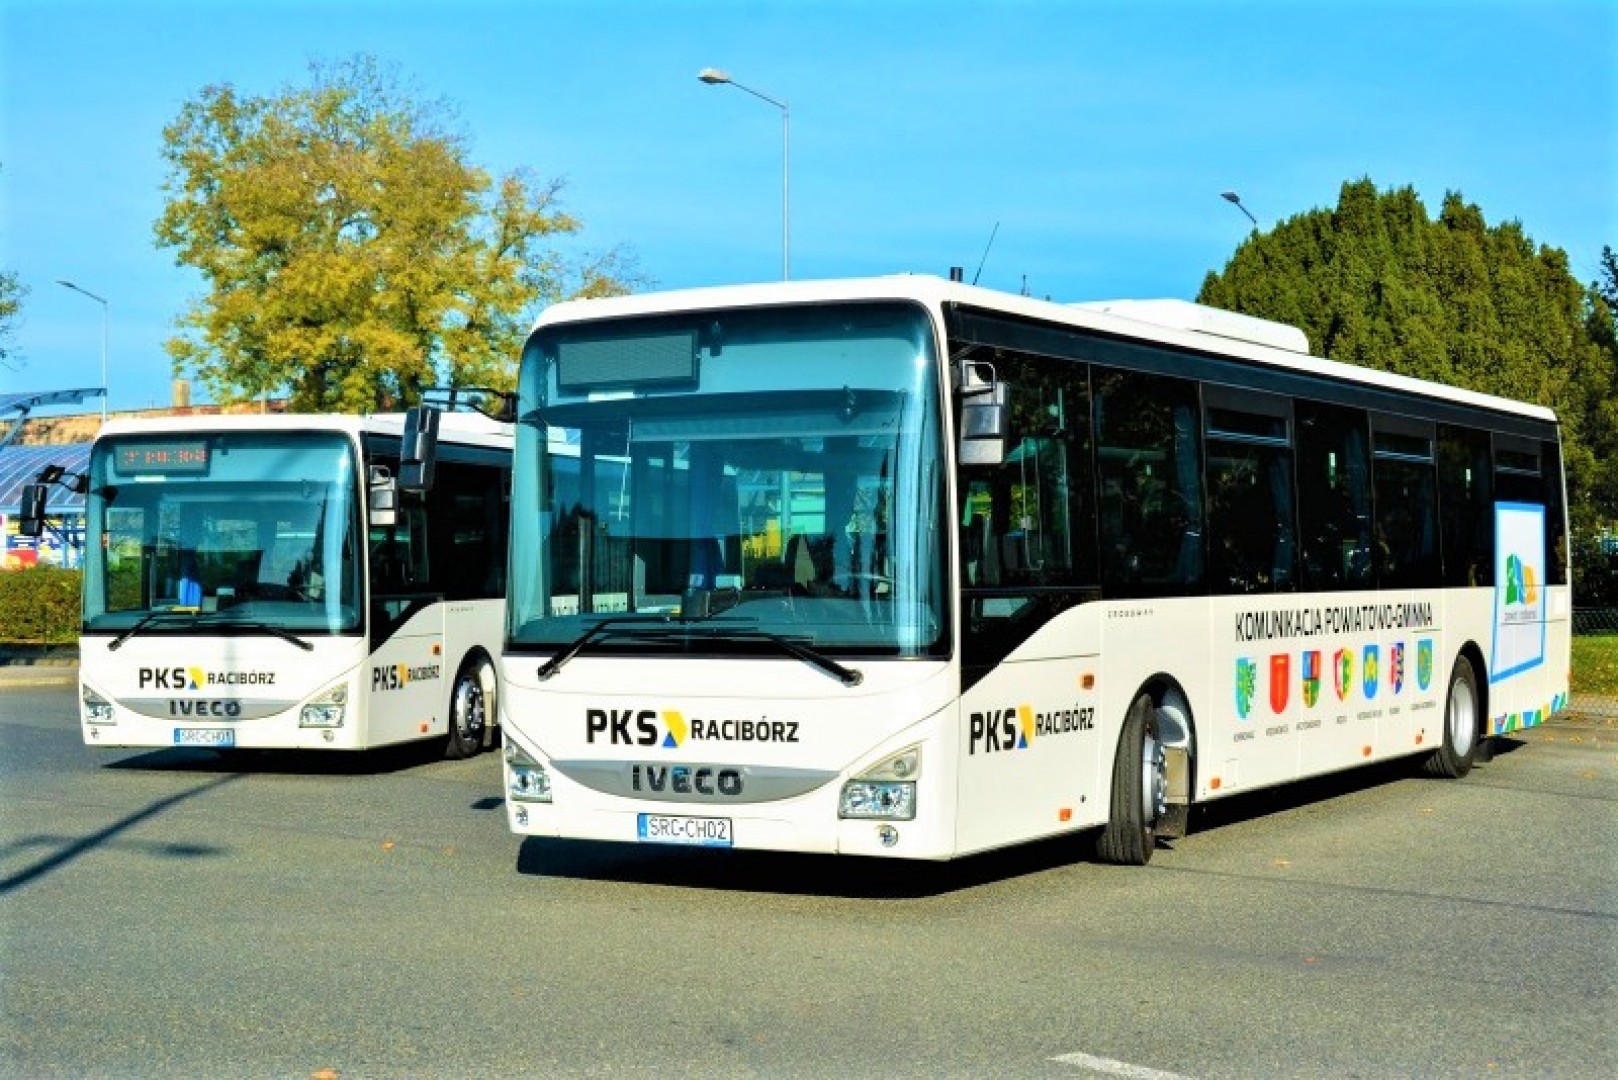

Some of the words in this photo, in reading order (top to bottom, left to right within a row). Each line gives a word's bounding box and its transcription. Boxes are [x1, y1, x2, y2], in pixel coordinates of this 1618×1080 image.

[1235, 608, 1323, 642] KOMUNIKACJA
[1324, 602, 1433, 634] POWIATOWO-GMINNA
[139, 667, 187, 689] PKS
[207, 669, 276, 685] RACIBÓRZ
[371, 664, 398, 692] PKS
[169, 700, 242, 717] IVECO
[586, 708, 658, 746] PKS
[691, 715, 800, 743] RACIBÓRZ
[969, 707, 1016, 755] PKS
[1035, 701, 1094, 736] RACIBÓRZ
[632, 764, 744, 796] IVECO
